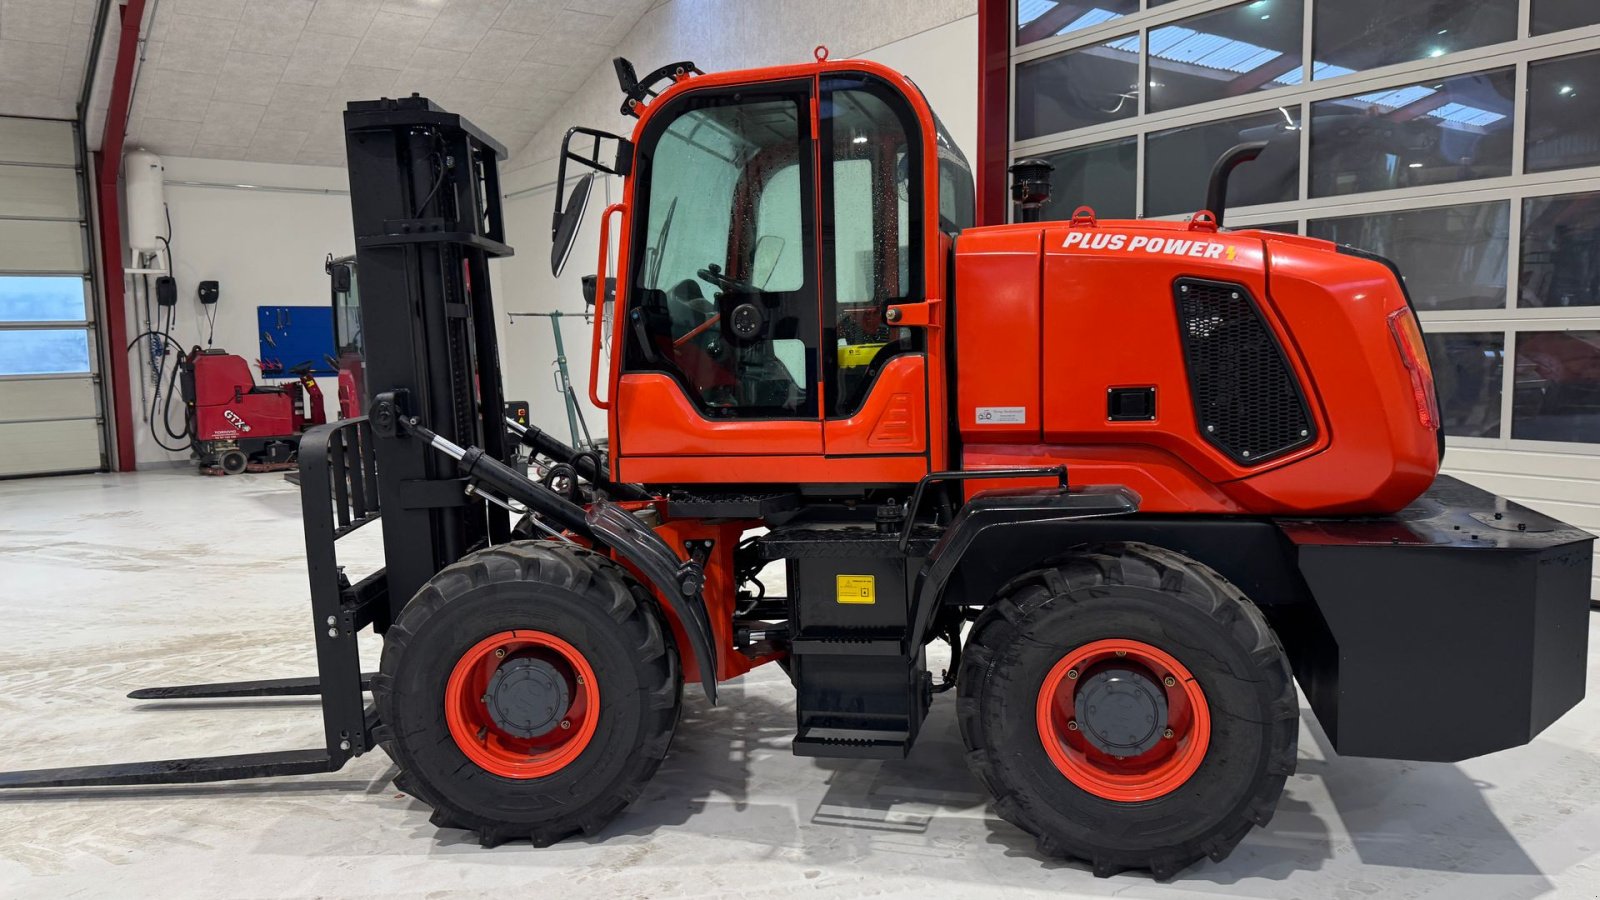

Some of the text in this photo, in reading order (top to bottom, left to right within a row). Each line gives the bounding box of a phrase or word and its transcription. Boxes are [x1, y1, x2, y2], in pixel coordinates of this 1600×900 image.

[1062, 232, 1224, 259] PLUS POWER
[224, 410, 245, 428] GTX
